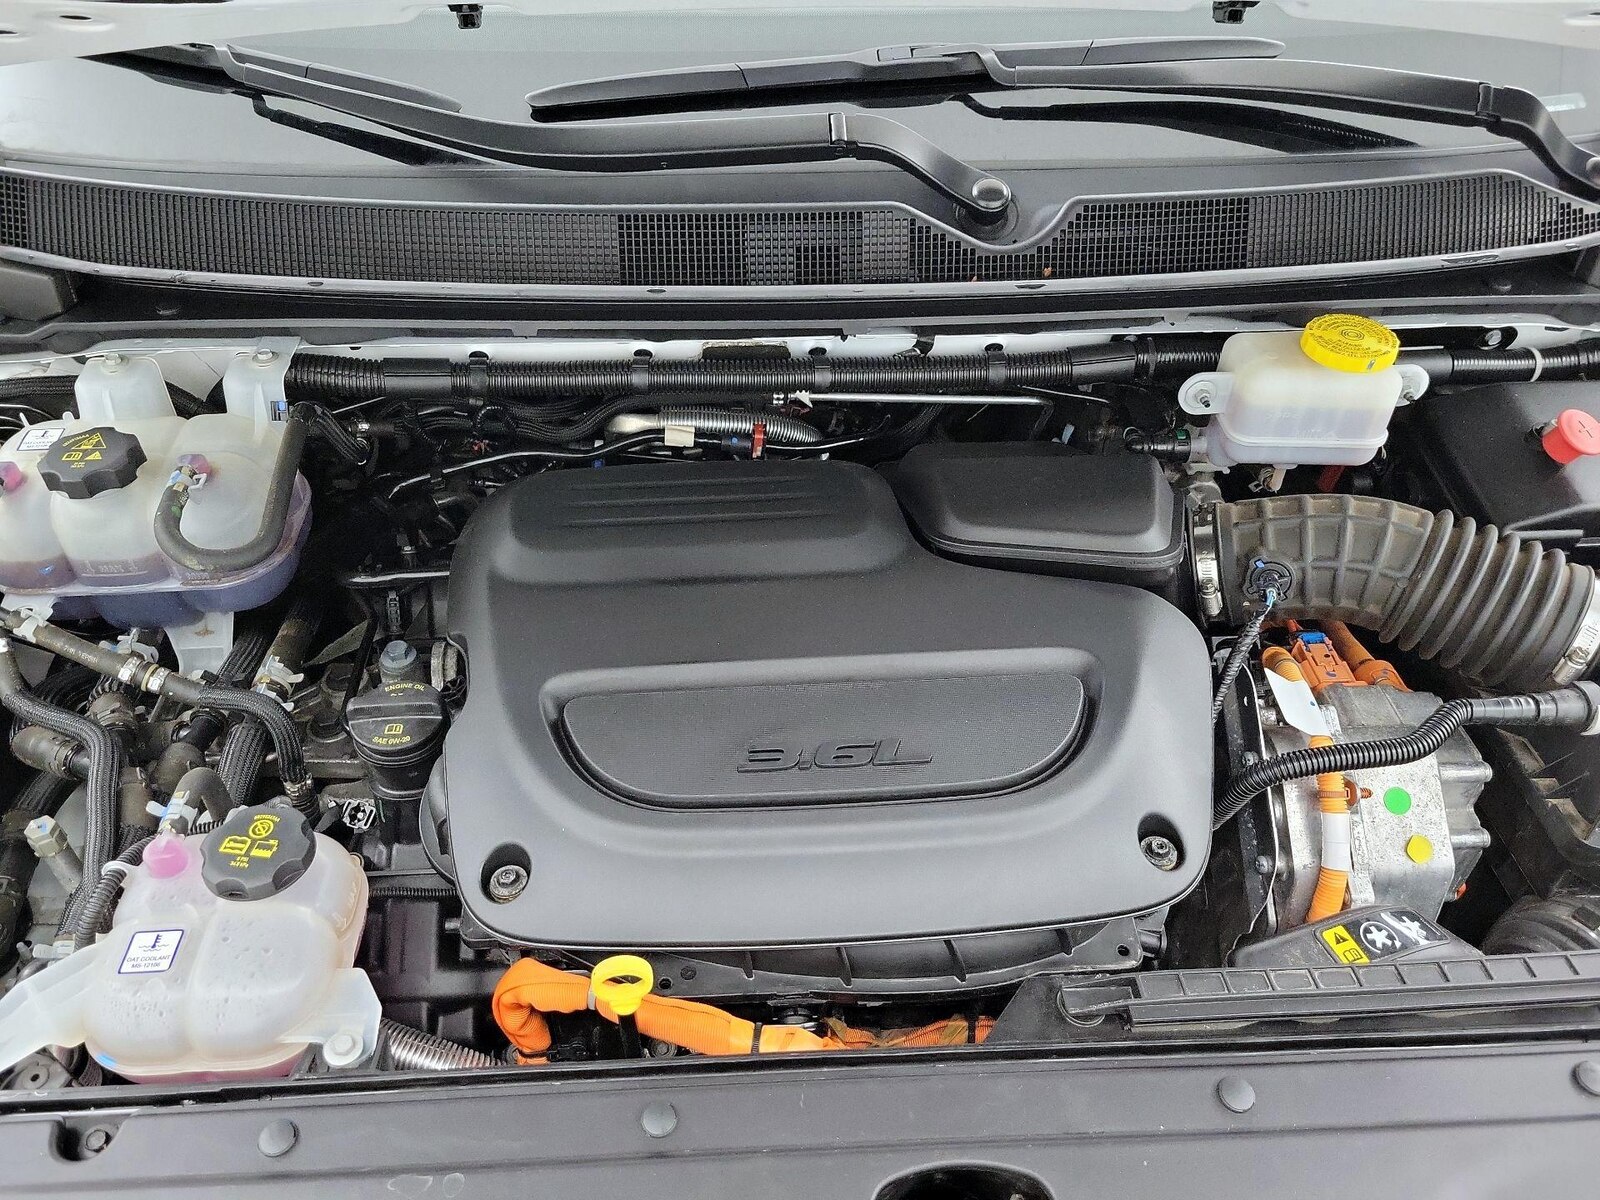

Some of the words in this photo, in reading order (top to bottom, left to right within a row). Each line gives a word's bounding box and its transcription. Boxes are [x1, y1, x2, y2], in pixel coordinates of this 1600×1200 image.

[384, 683, 413, 693] ENGINE
[413, 683, 426, 692] OIL
[372, 736, 388, 745] SAE
[737, 738, 933, 773] 3.6L
[140, 954, 171, 963] COOLANT
